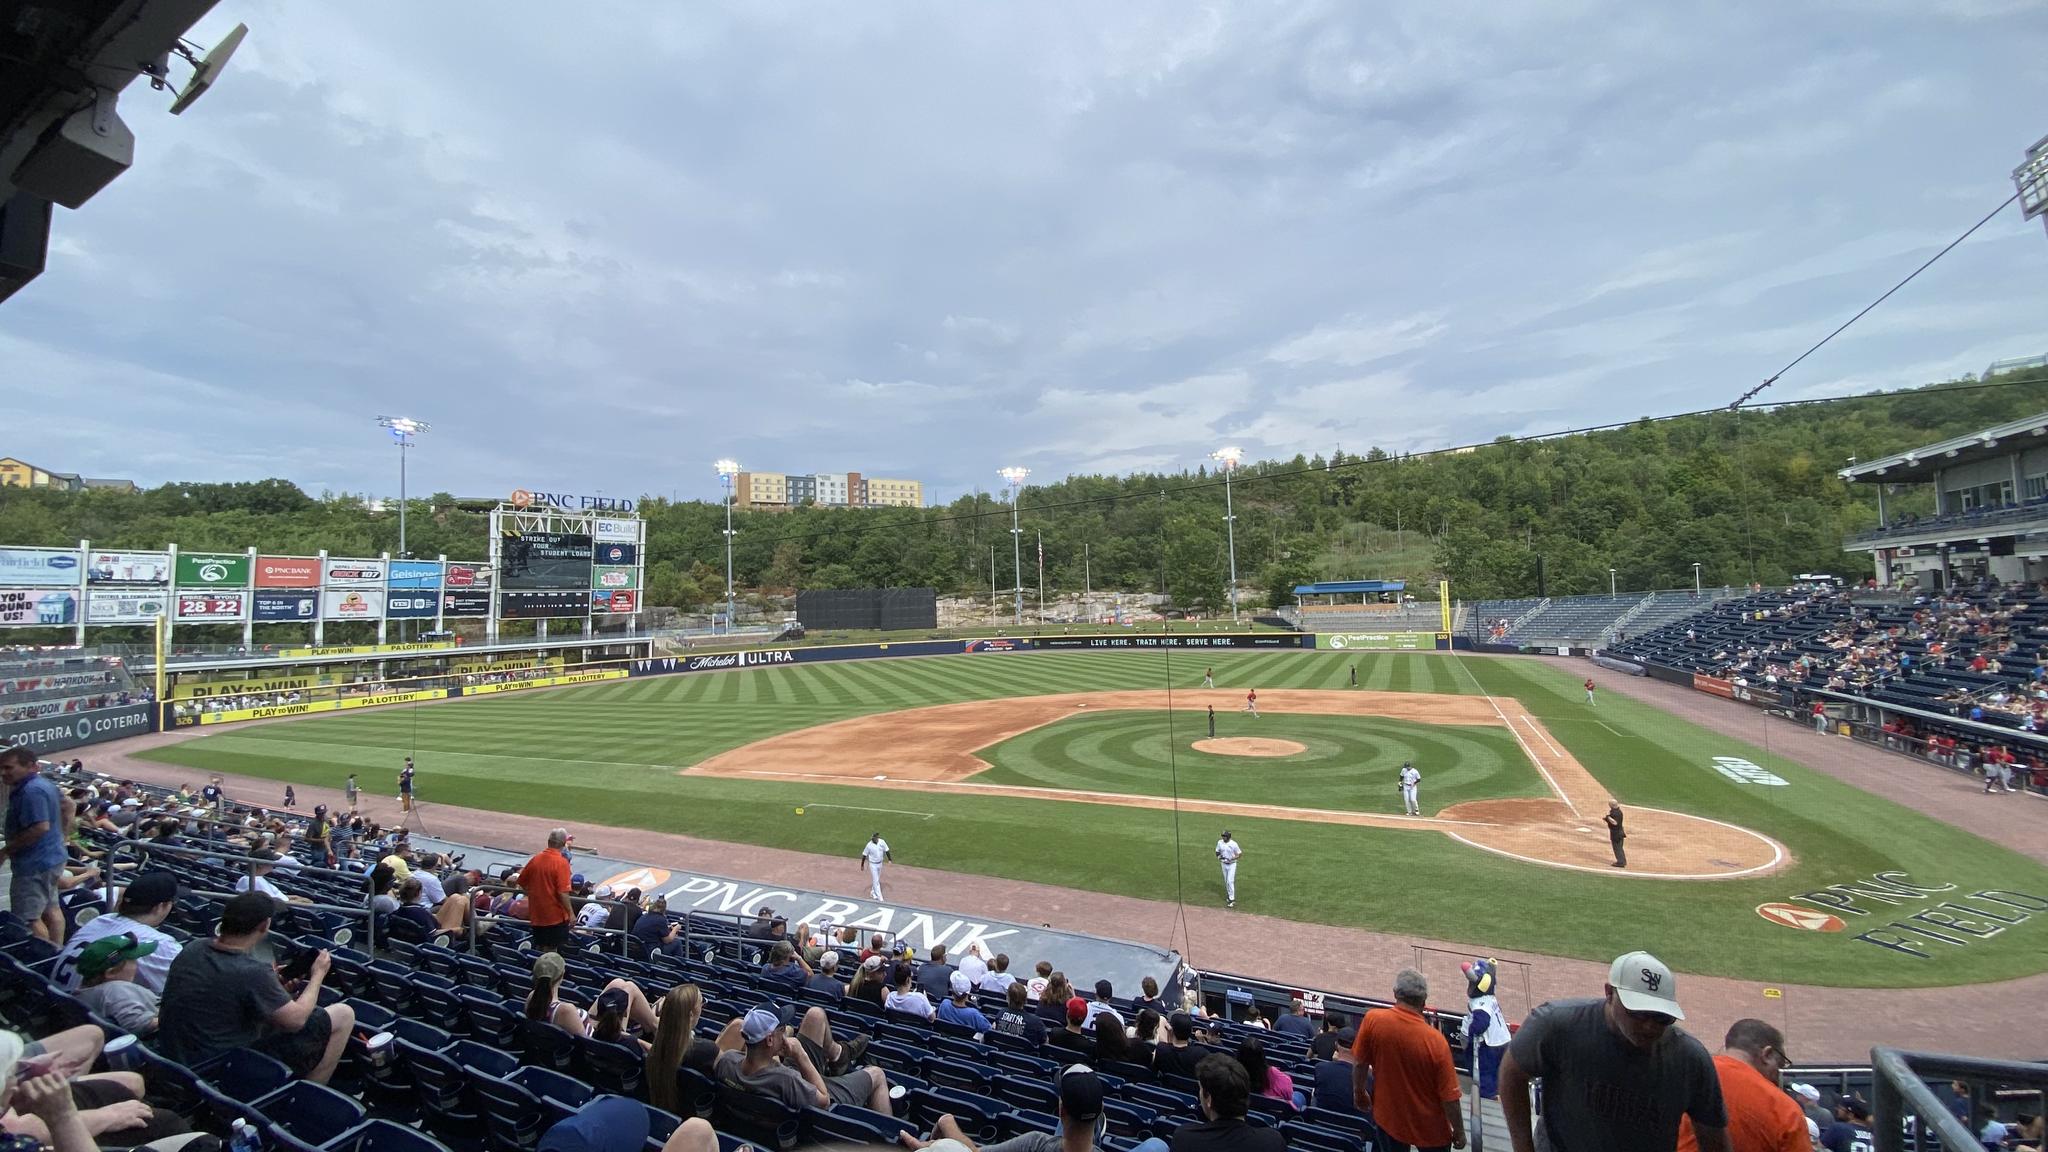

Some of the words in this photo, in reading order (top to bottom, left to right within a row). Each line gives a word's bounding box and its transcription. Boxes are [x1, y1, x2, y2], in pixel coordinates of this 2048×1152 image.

[533, 492, 575, 508] PNC
[581, 496, 632, 512] FIELD
[361, 570, 380, 578] 107
[391, 570, 439, 582] Geisinger
[1, 592, 26, 602] YOU
[183, 601, 206, 613] 28
[214, 601, 238, 612] 22
[4, 612, 24, 621] US!
[403, 643, 433, 651] LOTTERY
[1090, 638, 1112, 646] LIVE
[1135, 637, 1158, 646] TRAIN
[1186, 638, 1209, 646] SERVE
[1212, 638, 1235, 646] HERE.
[311, 648, 330, 656] PLAY
[338, 647, 354, 655] WIN!
[690, 655, 736, 670] Michelob
[747, 650, 794, 665] ULTRA
[579, 673, 607, 682] LOTTERY
[496, 683, 514, 691] PLAY
[518, 681, 534, 689] WIN!
[361, 698, 375, 706] PA
[377, 694, 416, 704] LOTTERY
[251, 708, 278, 718] PLAY
[288, 704, 309, 714] WIN!
[10, 726, 73, 748] COTERRA
[95, 712, 148, 732] COTERRA
[1789, 870, 1957, 916] PNC
[663, 876, 797, 923] PNC
[797, 898, 1020, 960] BANK
[1850, 890, 2048, 959] FIELD
